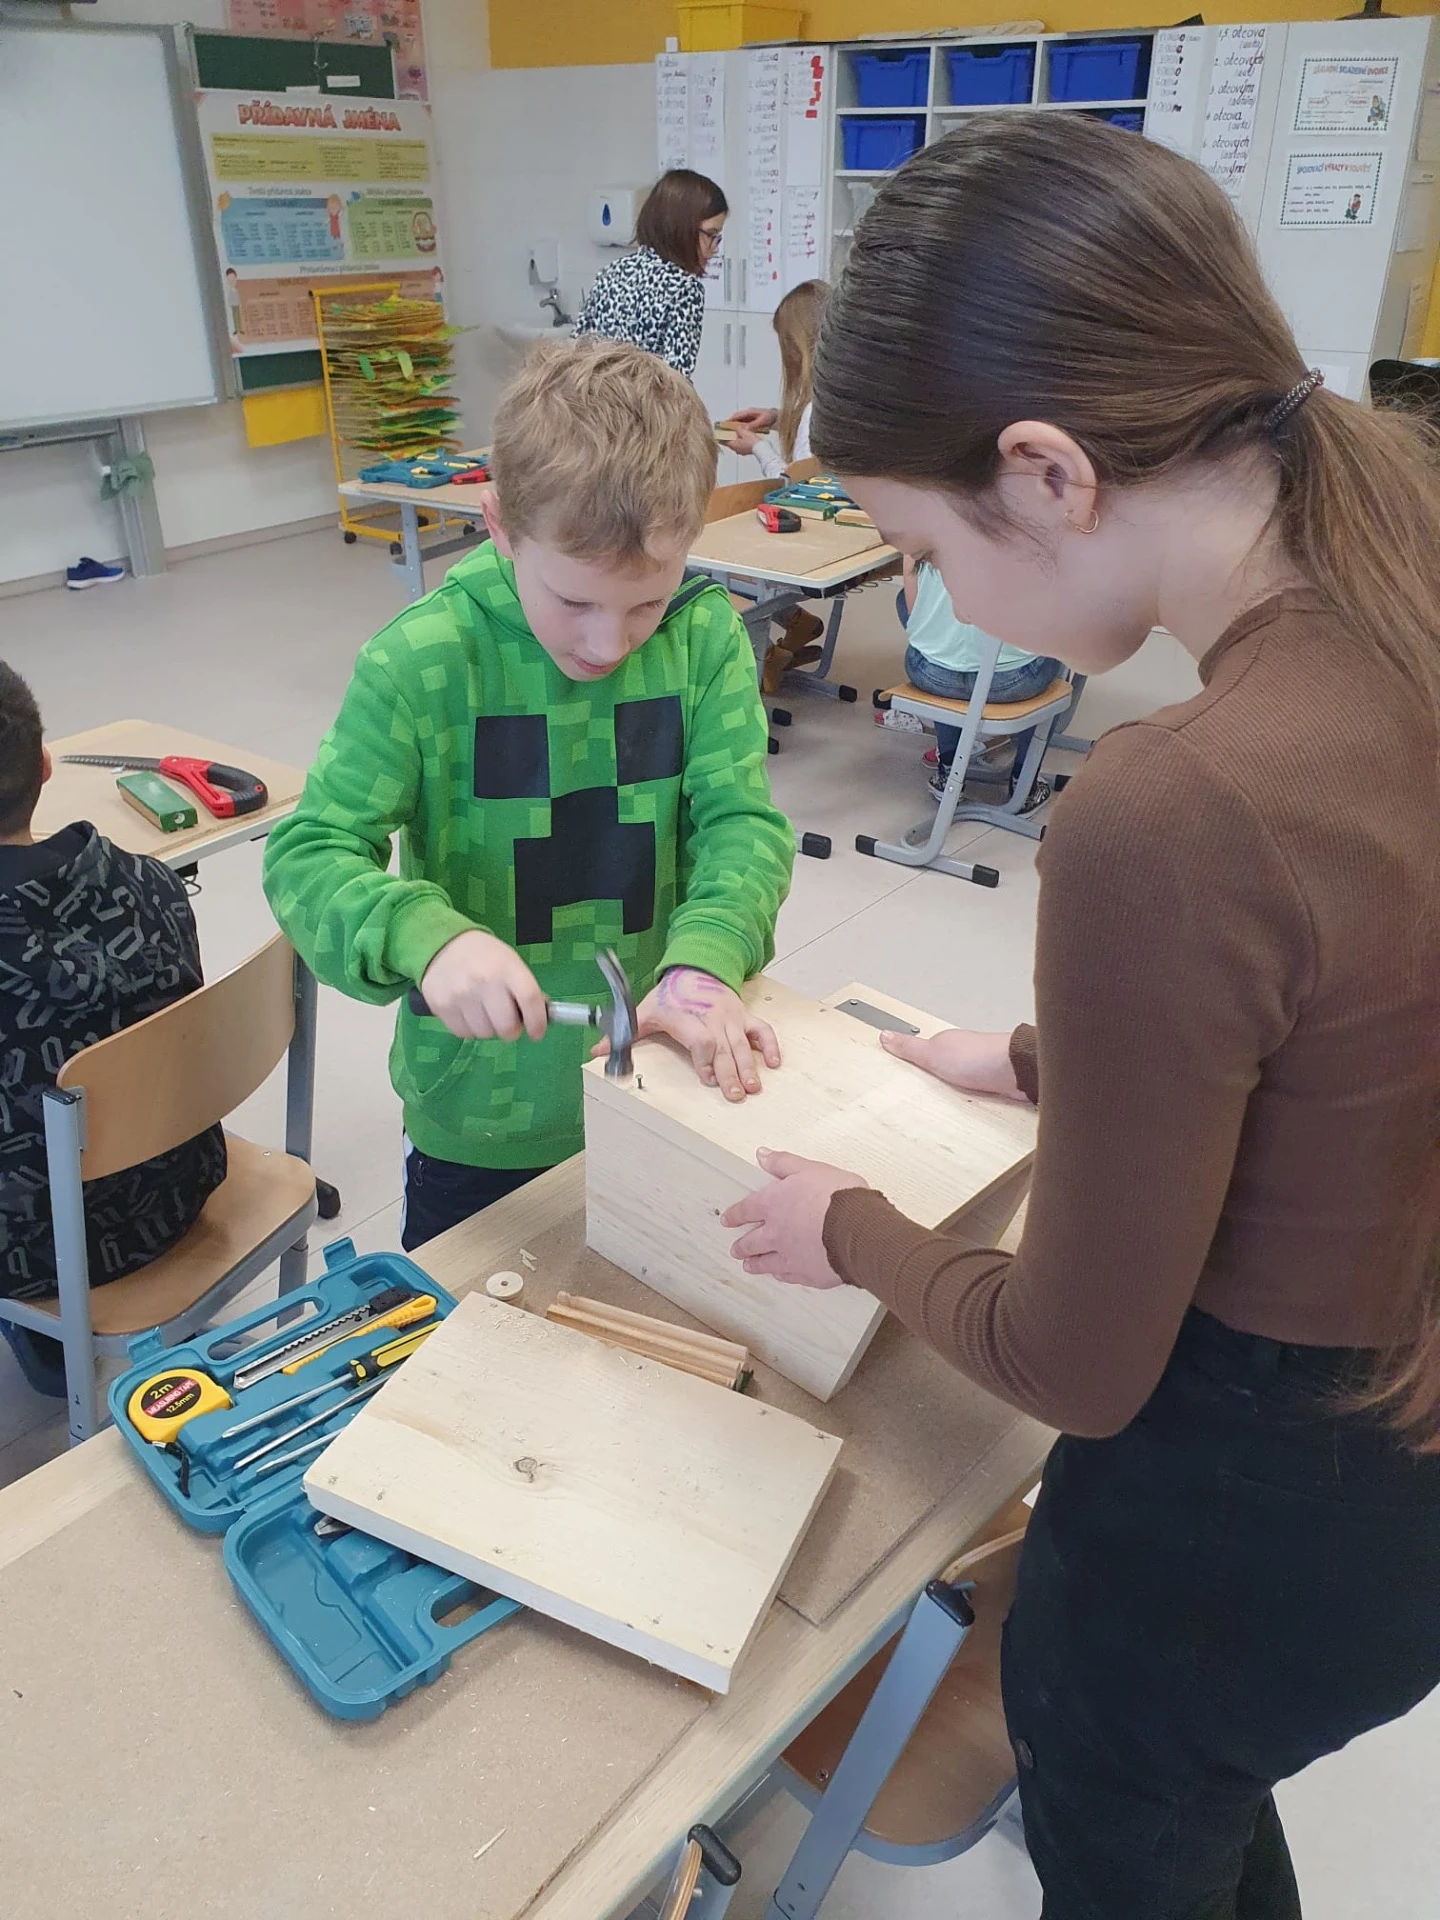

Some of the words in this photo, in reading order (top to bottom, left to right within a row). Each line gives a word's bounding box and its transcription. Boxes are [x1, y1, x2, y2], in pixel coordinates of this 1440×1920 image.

[238, 100, 337, 129] PŘÍDAVNÁ
[342, 105, 402, 131] JMÉNA
[148, 1390, 182, 1414] MEASURING
[180, 1379, 196, 1393] TAPE
[150, 1384, 174, 1399] 2m
[166, 1393, 195, 1414] 12.5mm
